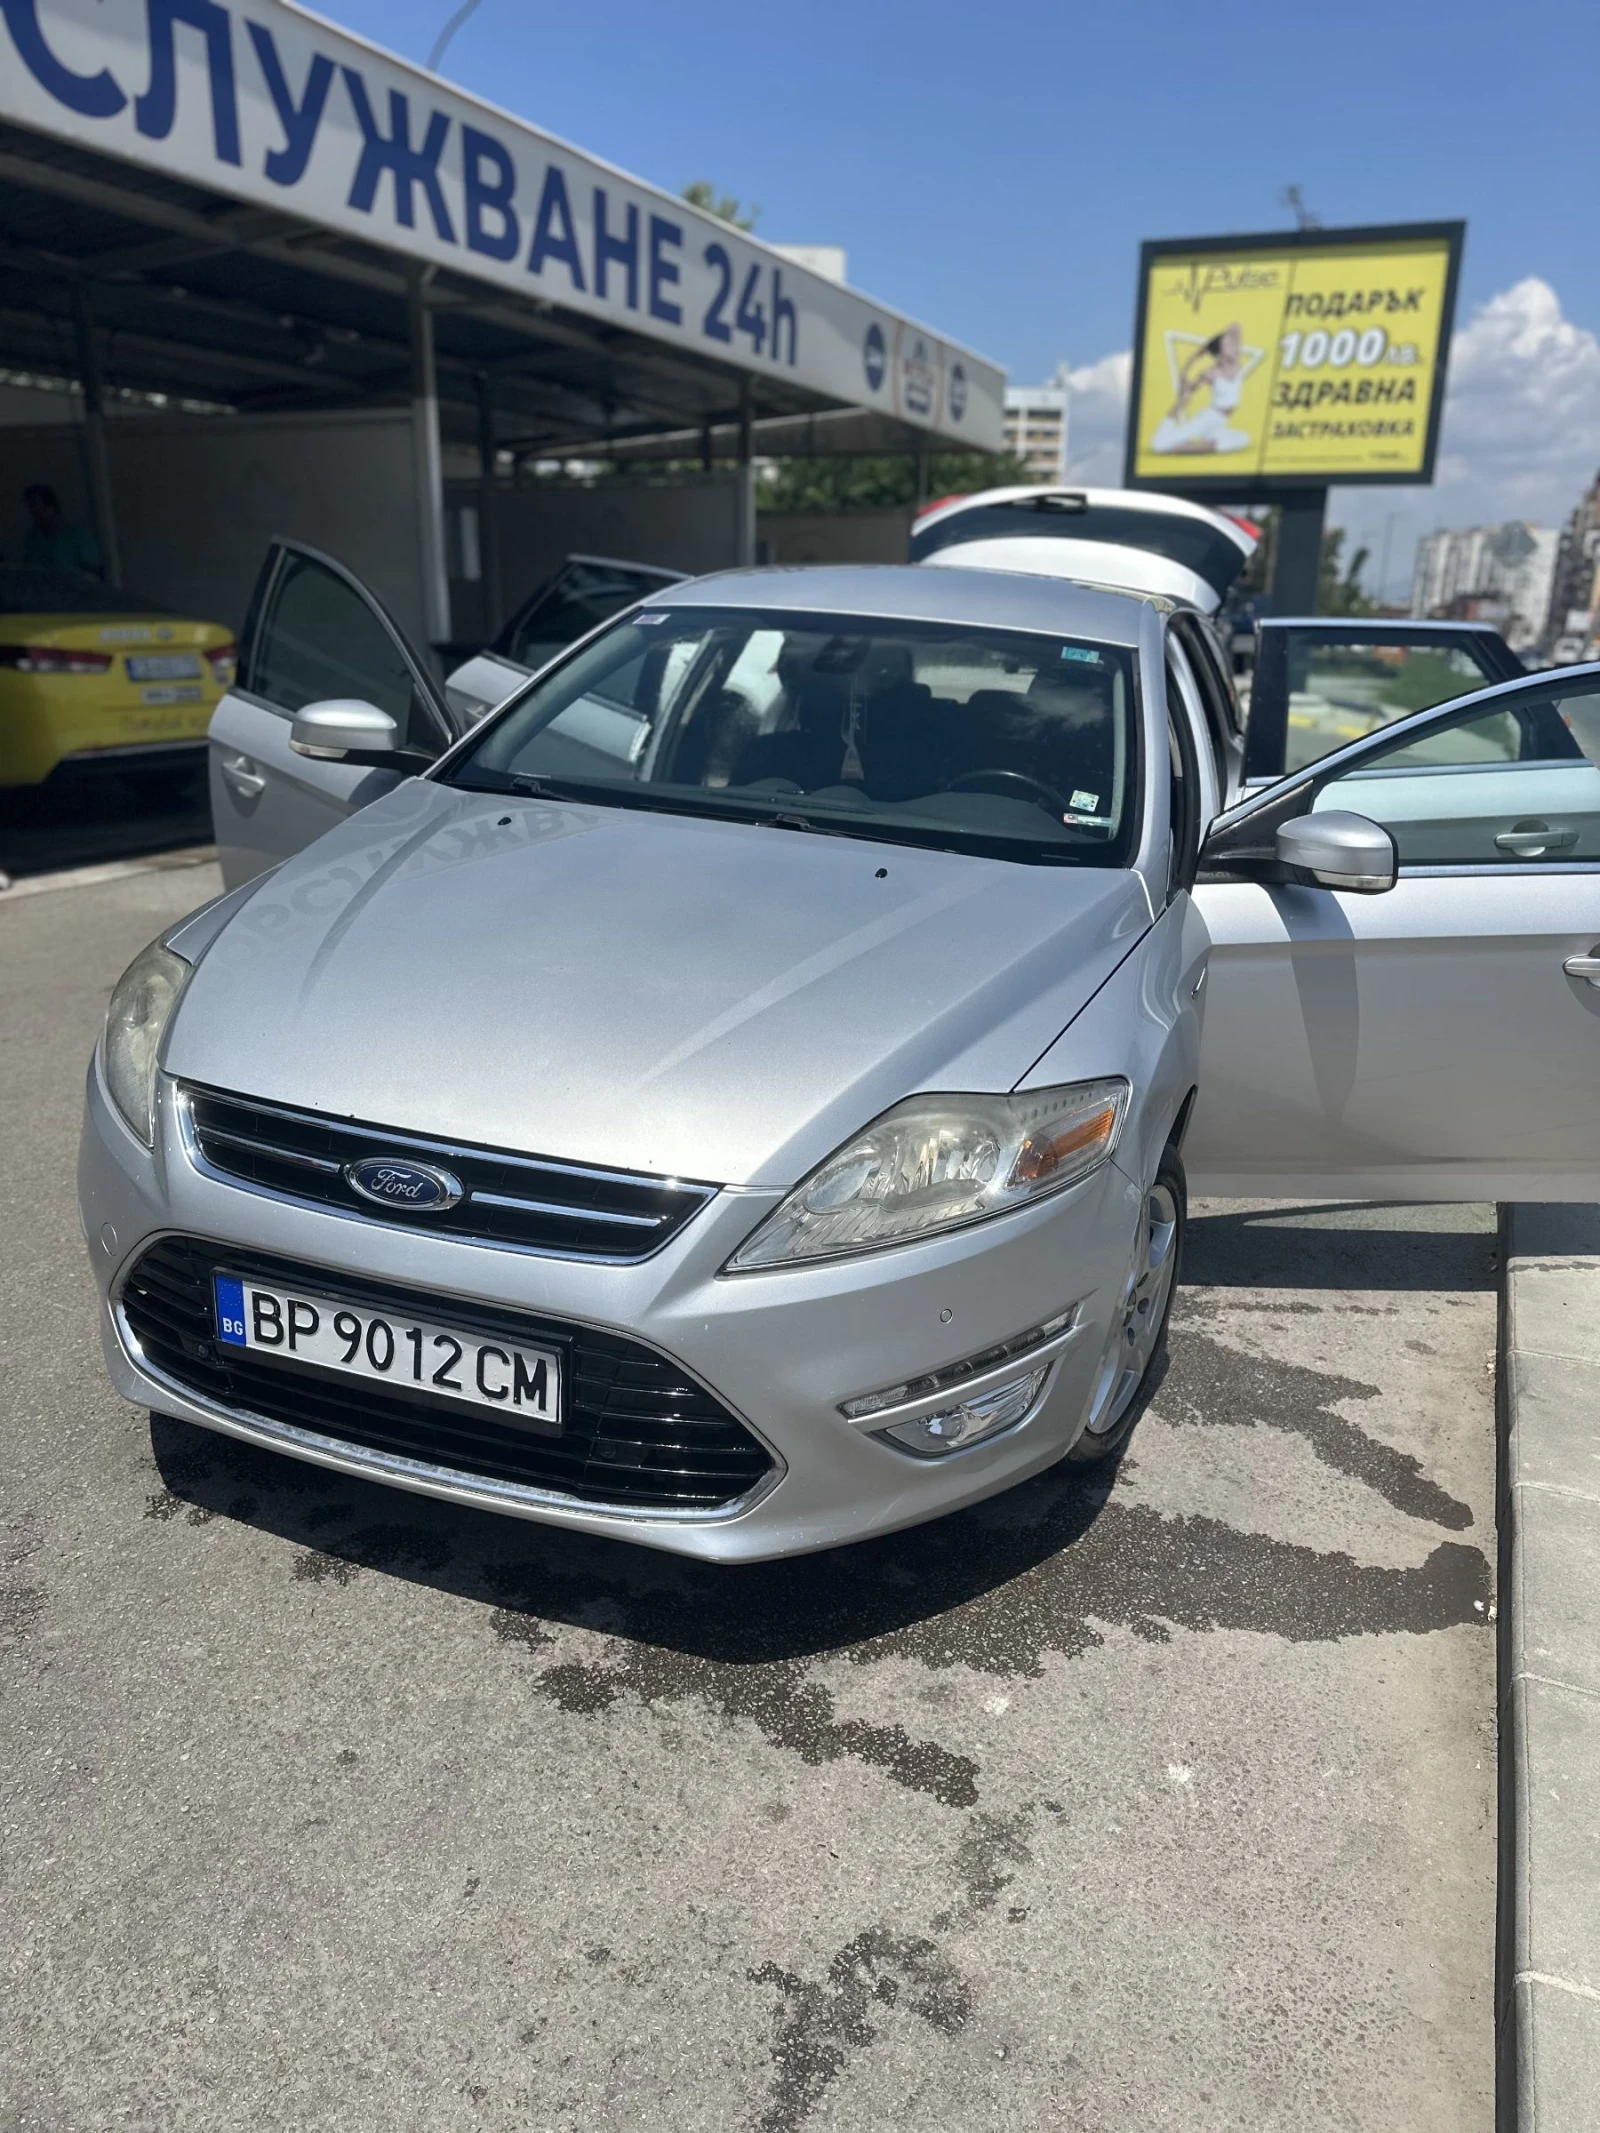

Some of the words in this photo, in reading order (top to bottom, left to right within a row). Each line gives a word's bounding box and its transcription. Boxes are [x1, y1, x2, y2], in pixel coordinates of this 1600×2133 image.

[704, 242, 798, 366] 24h
[1286, 289, 1424, 318] ПОДАРЪК
[1280, 327, 1387, 370] 1000
[1272, 378, 1416, 408] ЗДРАВНА
[1274, 420, 1415, 440] ЗАСТРАХОВКА
[371, 1169, 424, 1198] Ford
[222, 1317, 244, 1336] BG
